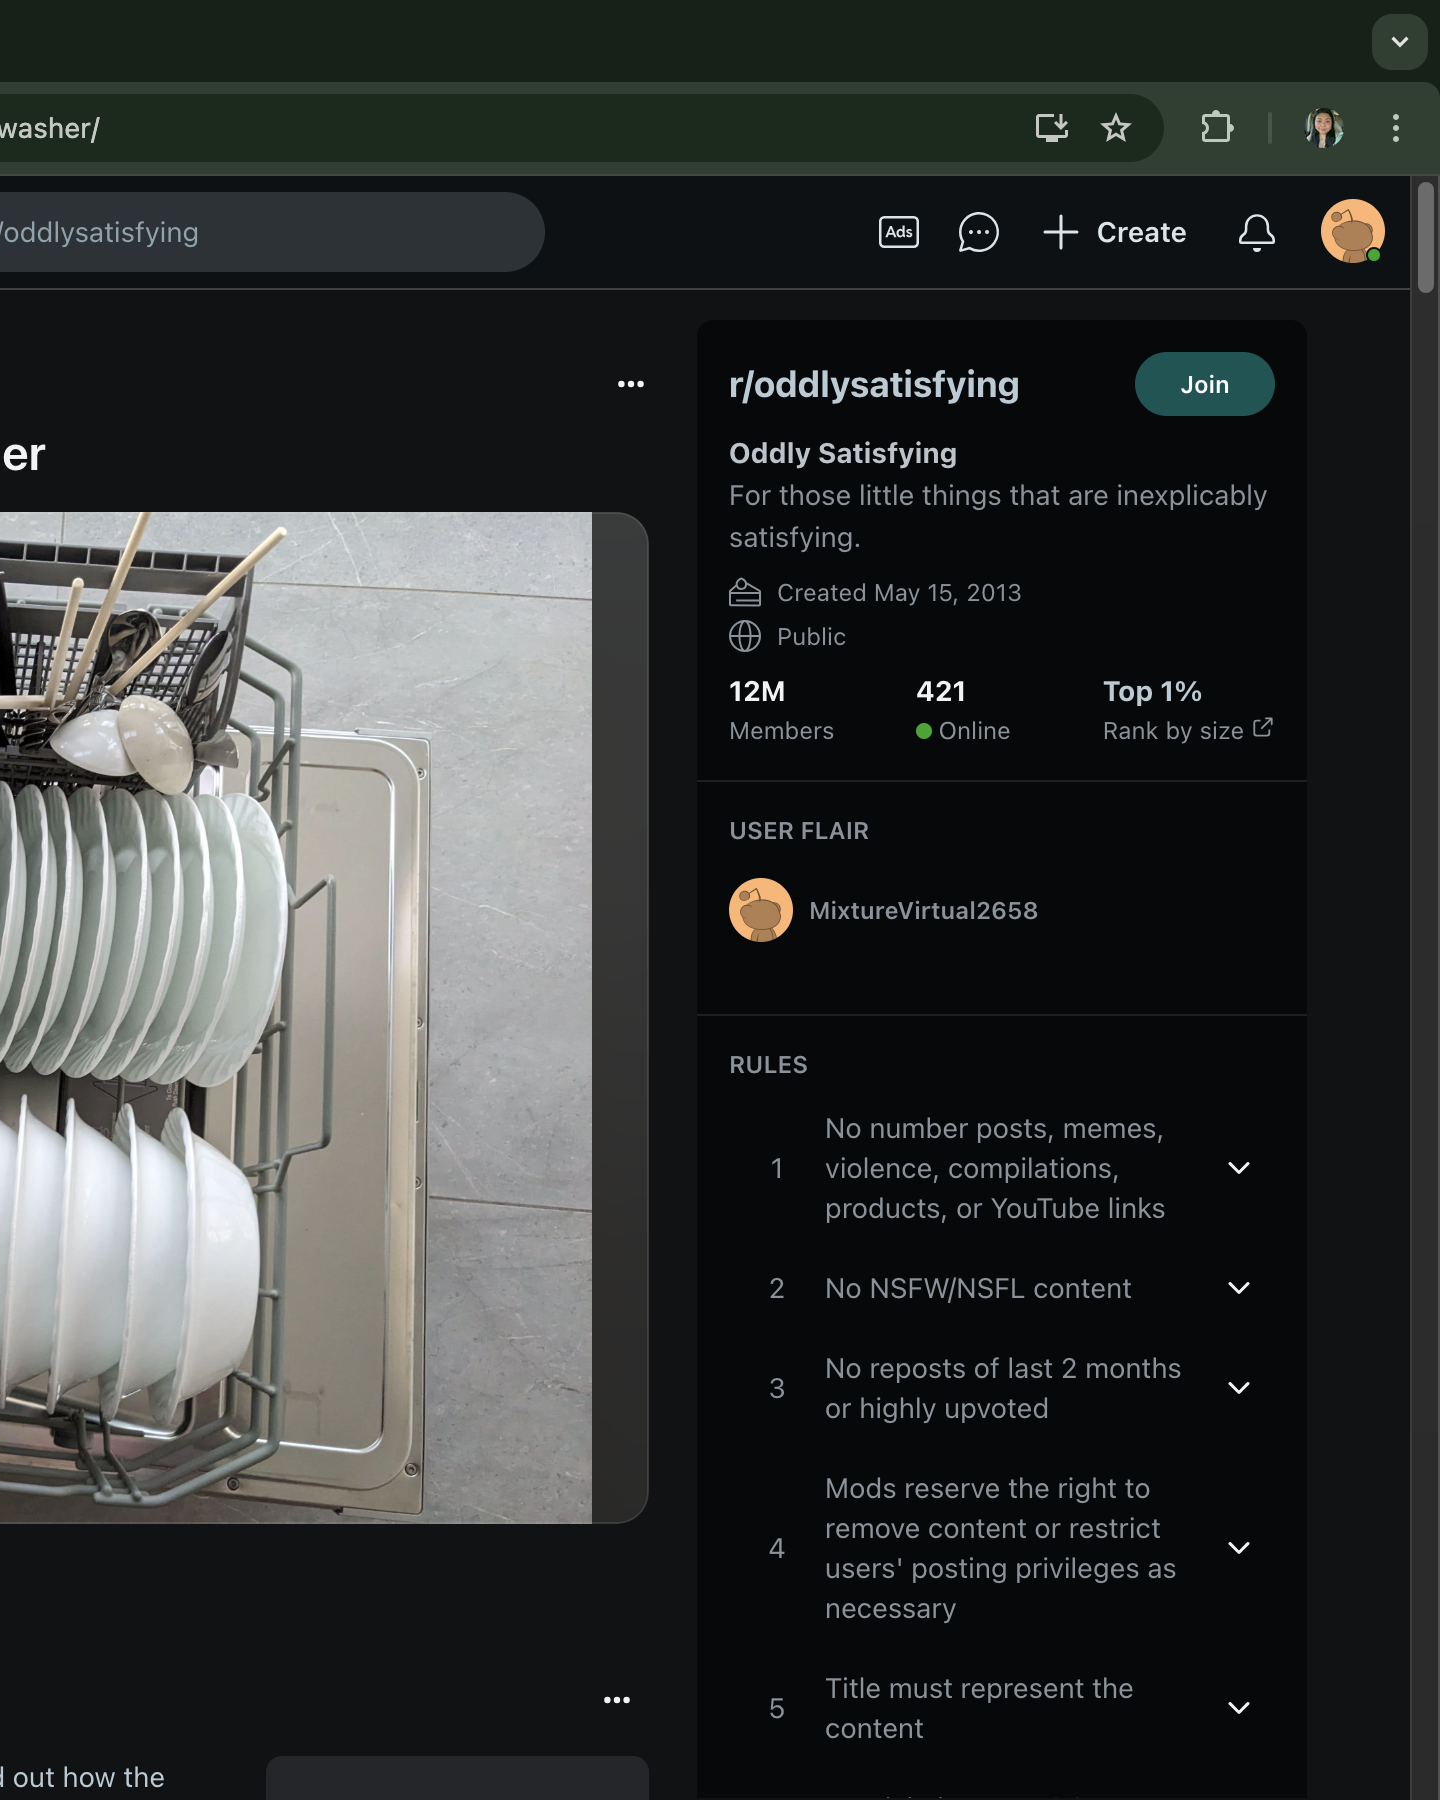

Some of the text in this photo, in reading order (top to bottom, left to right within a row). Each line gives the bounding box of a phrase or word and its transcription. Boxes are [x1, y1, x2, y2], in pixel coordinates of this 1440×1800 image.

[884, 224, 913, 239] Ads
[1097, 221, 1187, 244] Create
[730, 368, 1019, 405] r/oddlysatisfying
[1180, 373, 1229, 395] Join
[729, 440, 957, 470] Oddly Satisfying
[730, 483, 1268, 511] For those little things that are inexplicably
[729, 525, 860, 553] satisfying.
[777, 582, 1022, 607] Created May 15, 2013
[778, 626, 846, 646] Public
[729, 680, 785, 702] 12M
[916, 680, 964, 702] 421
[1102, 680, 1202, 707] Top 1%
[730, 720, 835, 740] Members
[939, 720, 1011, 741] Online
[1104, 720, 1244, 745] Rank by size
[730, 820, 869, 841] USER FLAIR
[810, 899, 1038, 921] MixtureVirtual2658
[730, 1054, 808, 1075] RULES
[826, 1116, 1163, 1144] No number posts, memes,
[771, 1157, 781, 1179] 1
[825, 1156, 1119, 1184] violence, compilations,
[826, 1196, 1166, 1224] products, or YouTube links
[769, 1277, 785, 1299] 2
[826, 1276, 1132, 1304] No NSFW/NSFL content
[826, 1356, 1182, 1384] No reposts of last 2 months
[769, 1377, 785, 1400] 3
[825, 1396, 1048, 1424] or highly upvoted
[826, 1476, 1151, 1504] Mods reserve the right to
[826, 1516, 1161, 1540] remove content or restrict
[768, 1537, 786, 1559] 4
[826, 1556, 1177, 1584] users' posting privileges as
[826, 1602, 957, 1624] necessary
[825, 1676, 1134, 1704] Title must represent the
[769, 1697, 785, 1720] 5
[825, 1718, 924, 1740] content
[13, 1767, 55, 1788] out
[63, 1765, 116, 1788] how
[123, 1765, 165, 1789] the
